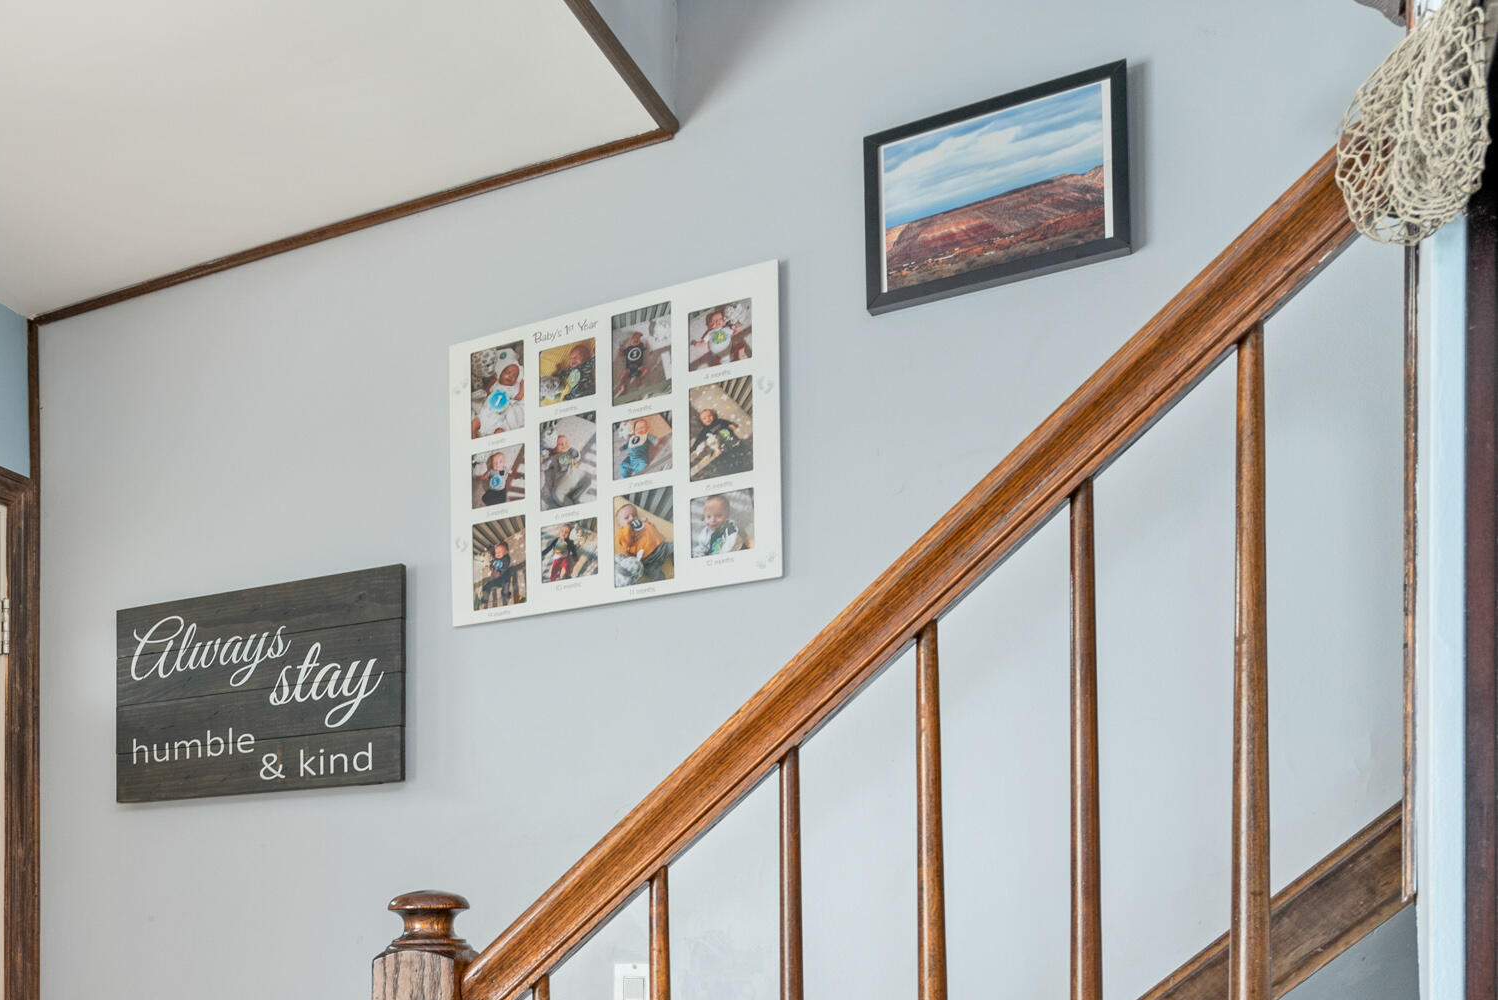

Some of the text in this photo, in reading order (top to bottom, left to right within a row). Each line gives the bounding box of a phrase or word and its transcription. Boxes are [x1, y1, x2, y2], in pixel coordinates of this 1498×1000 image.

[577, 319, 599, 332] Year
[129, 614, 292, 687] Always
[268, 641, 385, 728] stay
[131, 727, 255, 765] humble
[259, 741, 374, 780] & kind
